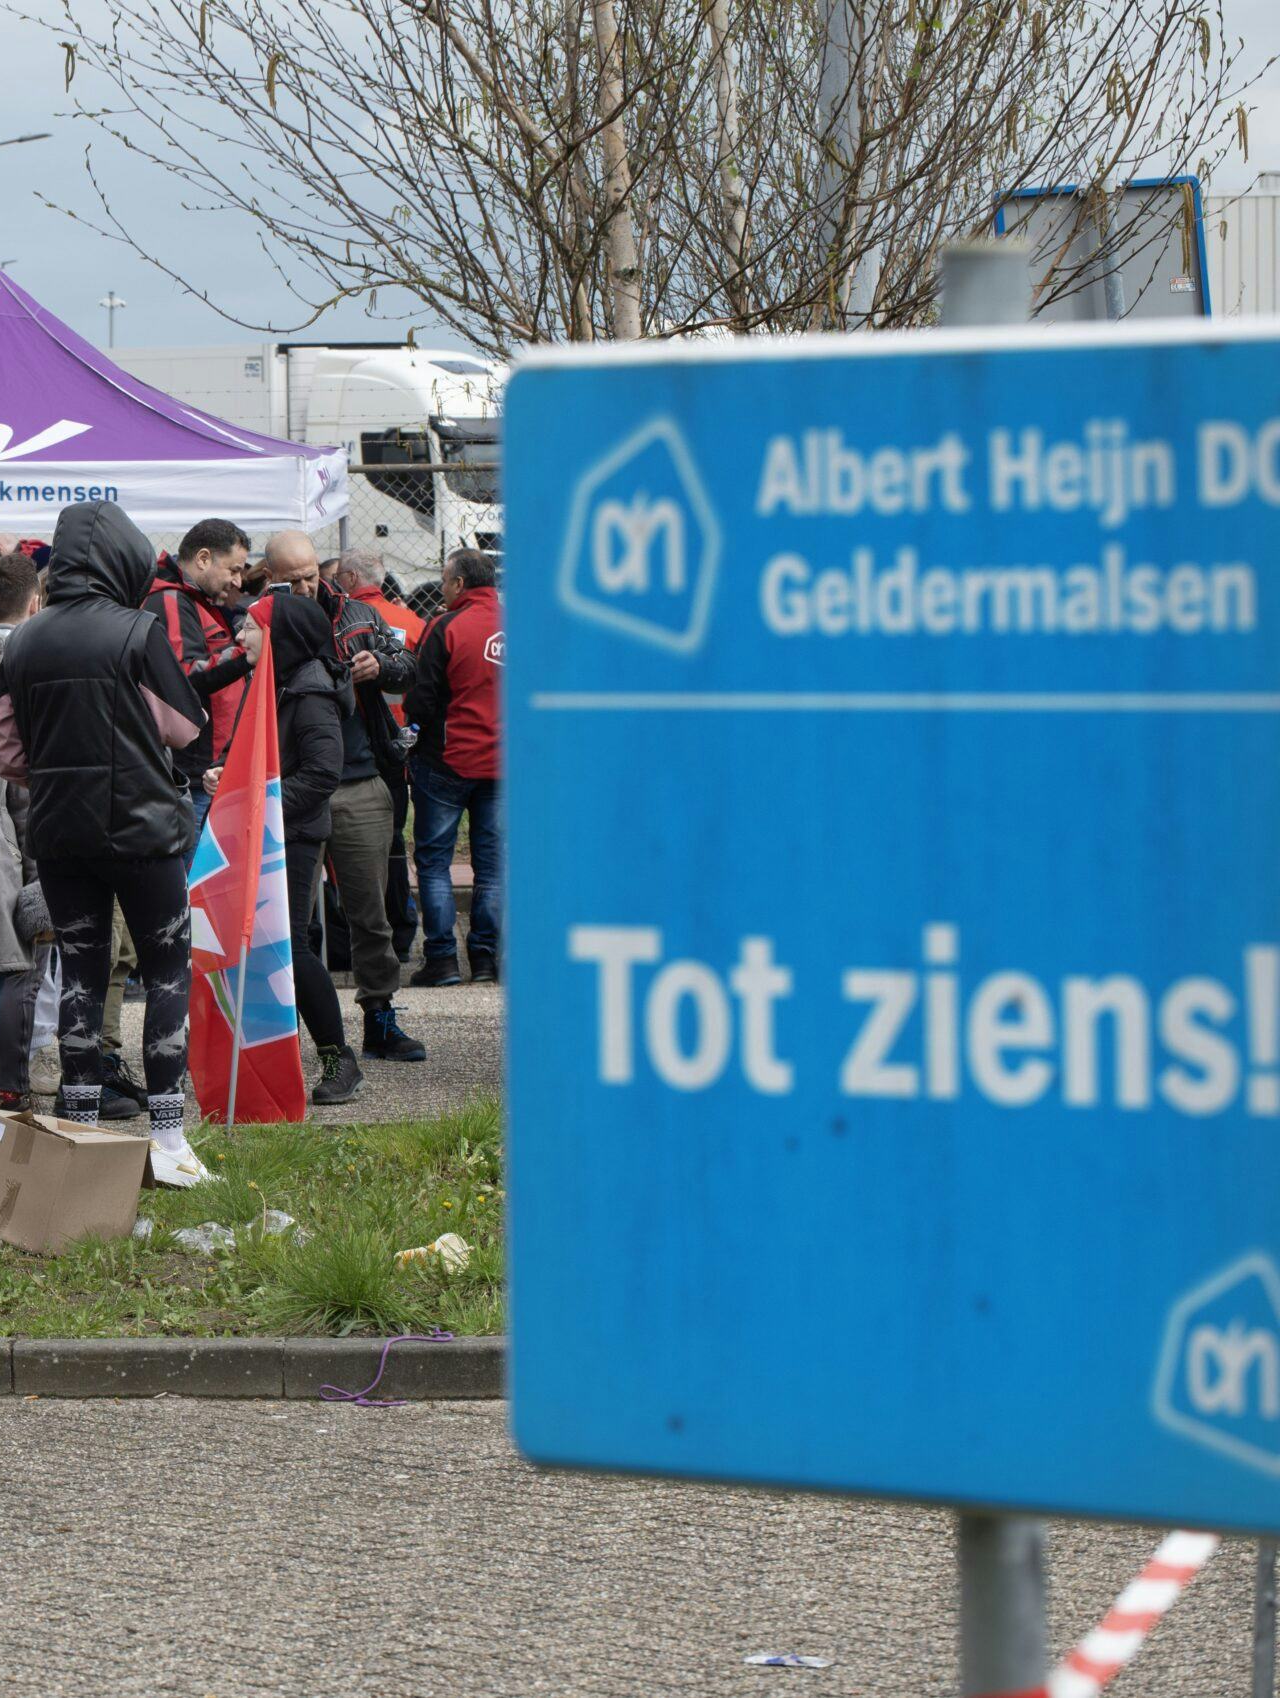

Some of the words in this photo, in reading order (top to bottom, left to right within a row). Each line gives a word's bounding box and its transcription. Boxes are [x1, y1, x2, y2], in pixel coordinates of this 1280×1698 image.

[756, 427, 969, 515] Albert
[989, 417, 1173, 528] Heijn
[761, 543, 1256, 636] Geldermalsen
[567, 924, 794, 1096] Tot
[840, 922, 1280, 1117] ziens!
[154, 1109, 181, 1120] VANS
